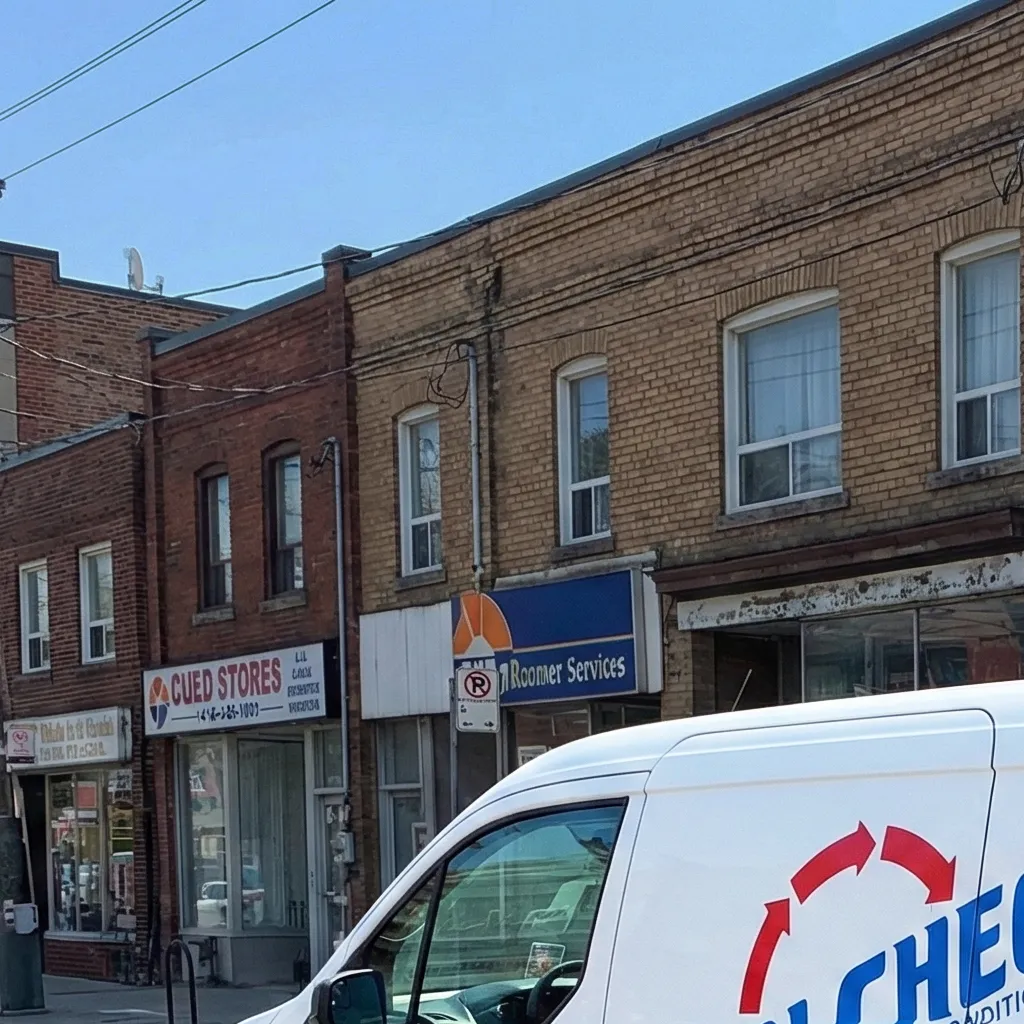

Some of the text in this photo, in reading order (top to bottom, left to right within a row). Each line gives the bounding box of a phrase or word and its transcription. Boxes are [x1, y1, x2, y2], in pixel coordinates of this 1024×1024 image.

[171, 657, 282, 706] CUED STORES
[567, 653, 626, 683] Services
